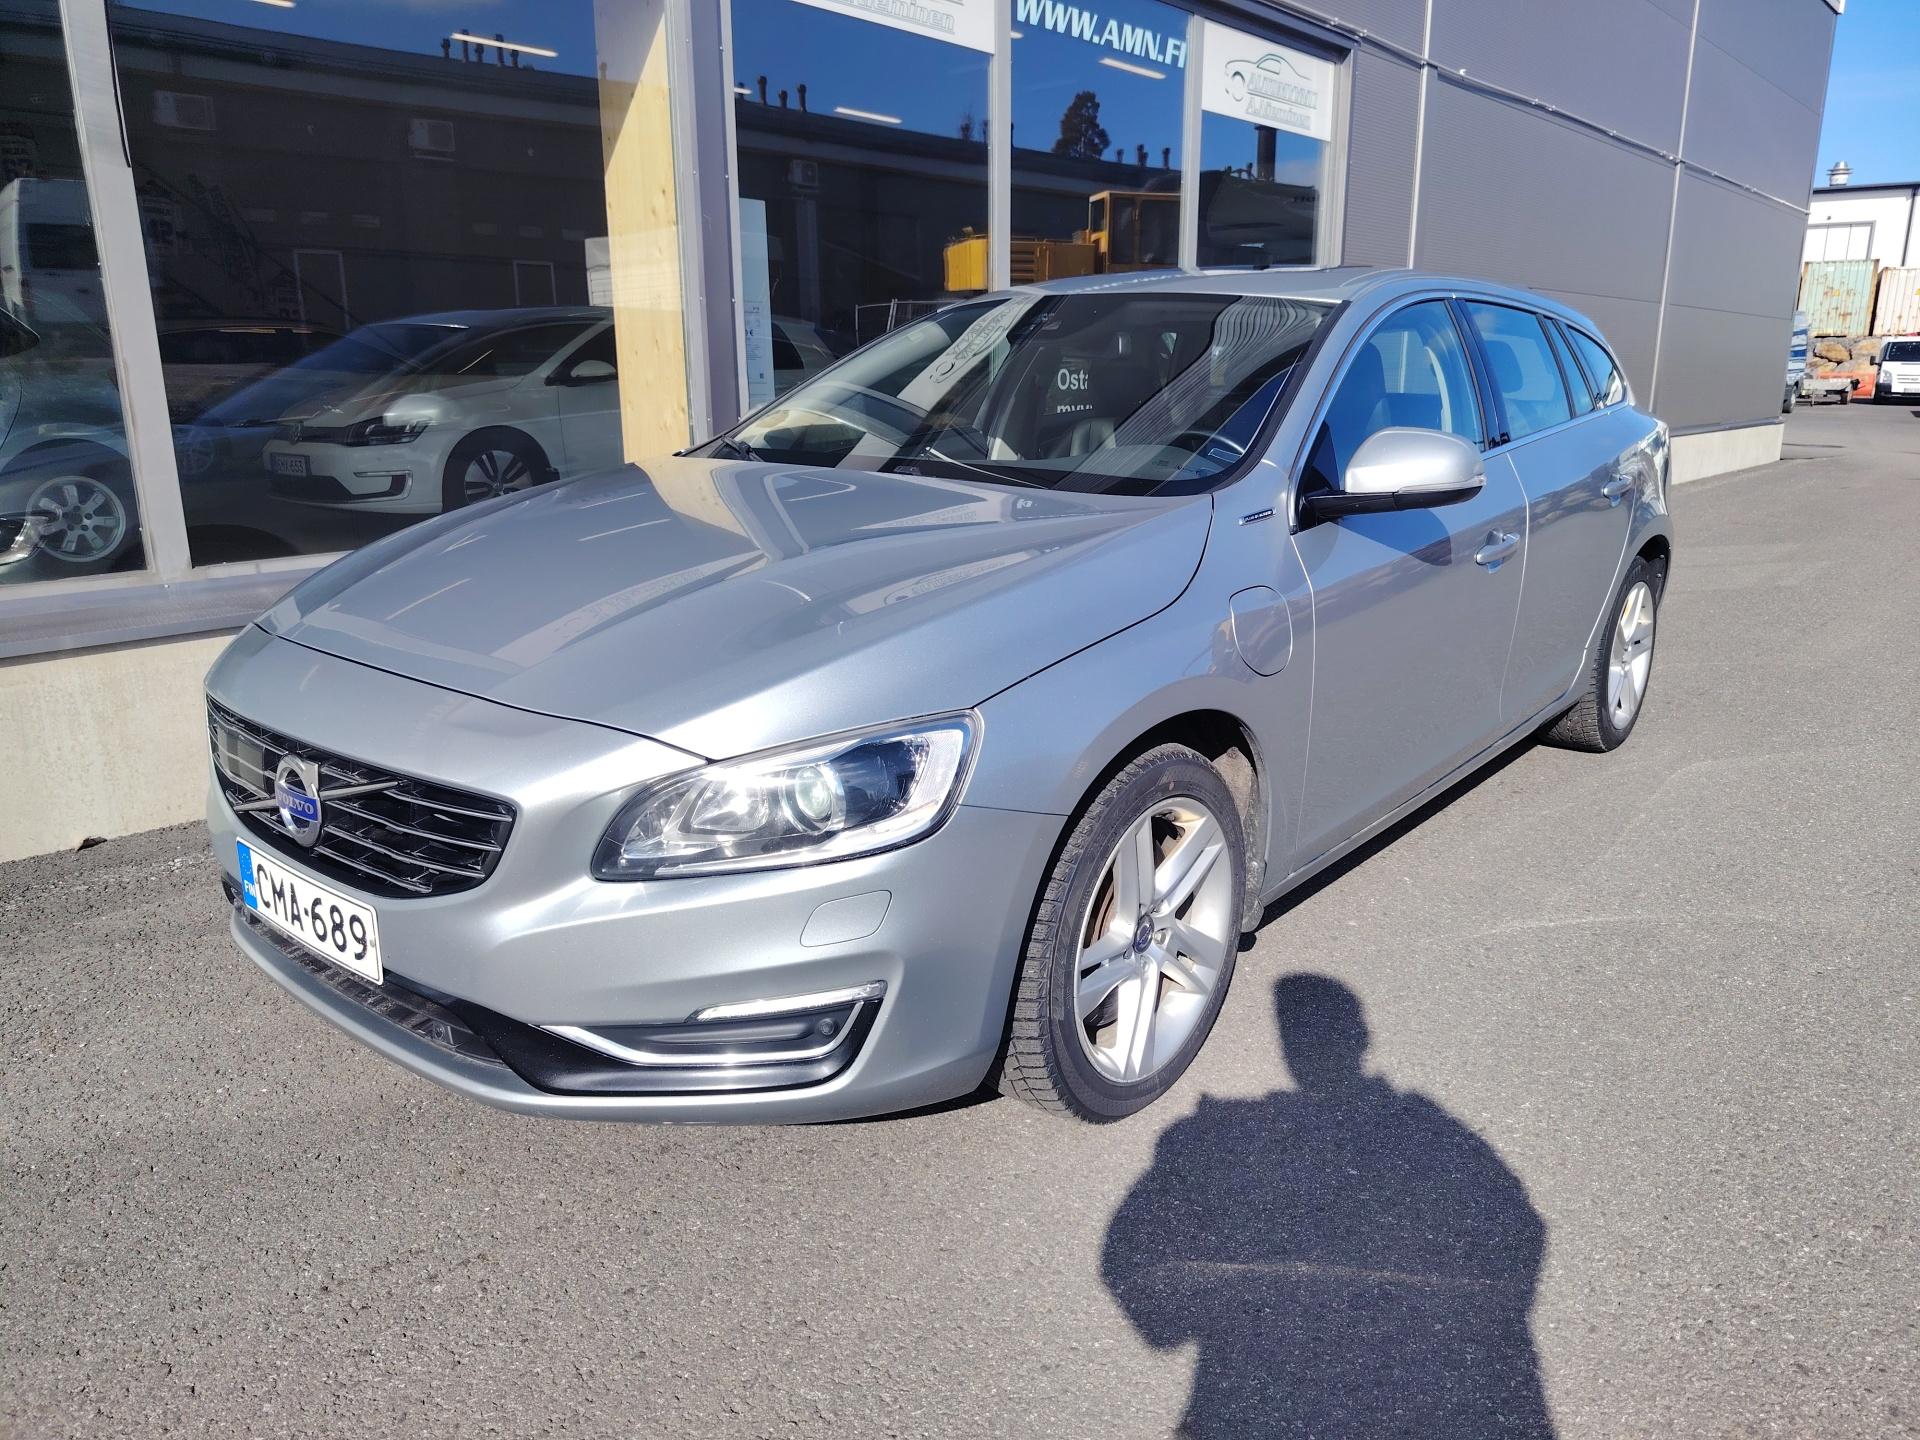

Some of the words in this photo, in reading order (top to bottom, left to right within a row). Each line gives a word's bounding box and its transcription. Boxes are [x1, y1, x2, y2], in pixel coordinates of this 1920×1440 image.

[1016, 0, 1187, 68] WWW.AMN.FI
[277, 790, 314, 815] VOLVO
[257, 864, 367, 960] CMA-689
